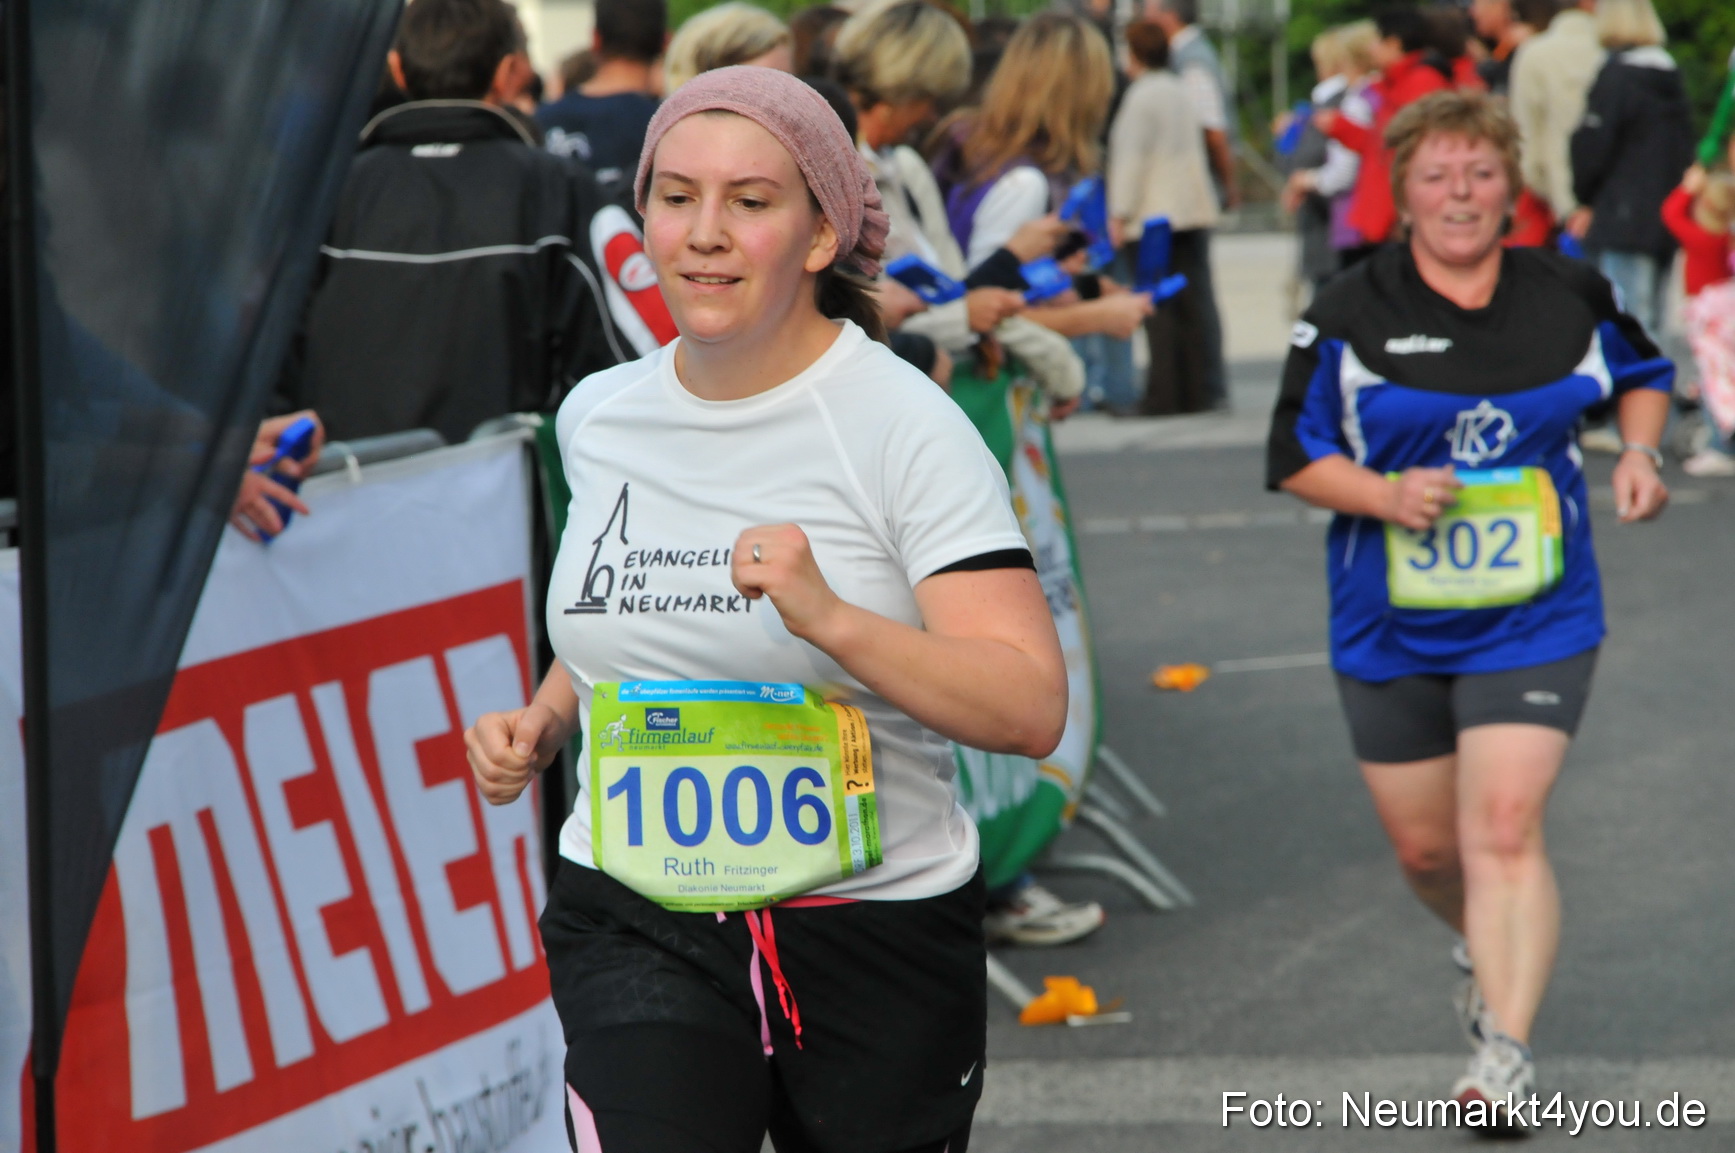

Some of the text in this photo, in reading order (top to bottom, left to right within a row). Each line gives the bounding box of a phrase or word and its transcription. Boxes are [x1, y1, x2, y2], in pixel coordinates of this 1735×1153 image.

[1408, 518, 1521, 571] 302
[624, 548, 730, 569] EVANGELI
[620, 573, 646, 591] IN
[619, 593, 752, 615] NEUMARKT
[628, 728, 715, 744] firmenlauf
[607, 766, 832, 847] 1006
[663, 857, 778, 877] Ruth Fritzinger
[678, 884, 766, 893] Diakonie Neumarkt
